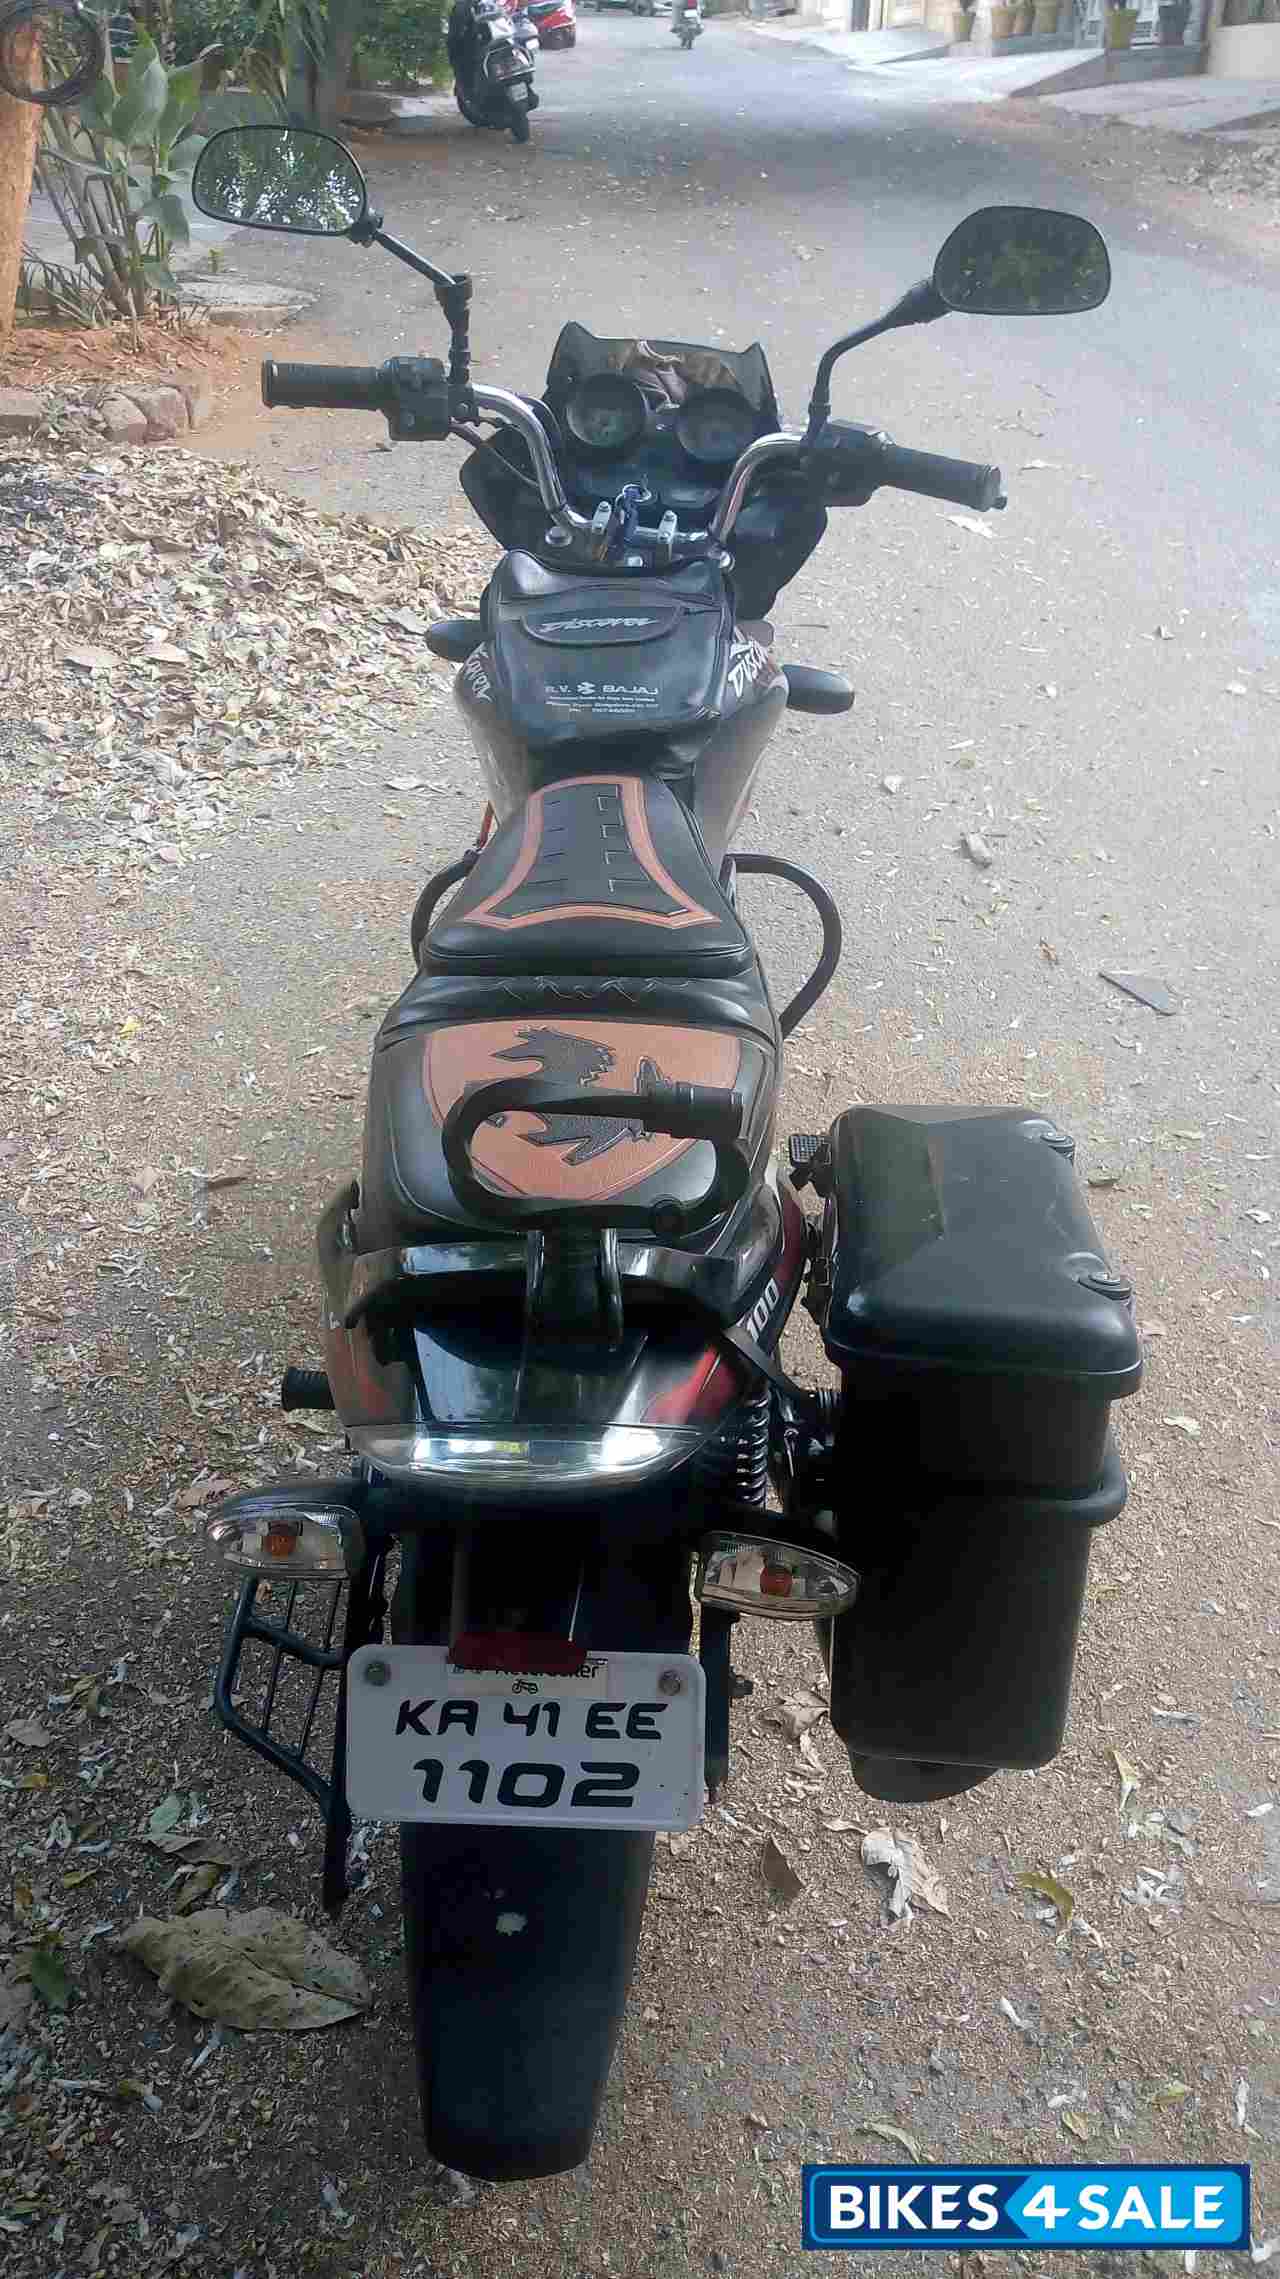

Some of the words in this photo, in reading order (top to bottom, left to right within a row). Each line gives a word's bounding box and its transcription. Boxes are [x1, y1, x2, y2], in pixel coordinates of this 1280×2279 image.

[602, 684, 660, 696] BAJAJ
[737, 1277, 780, 1343] 100
[395, 1699, 480, 1737] KA
[503, 1701, 561, 1738] 41
[584, 1701, 669, 1740] EE
[412, 1758, 641, 1809] 1102
